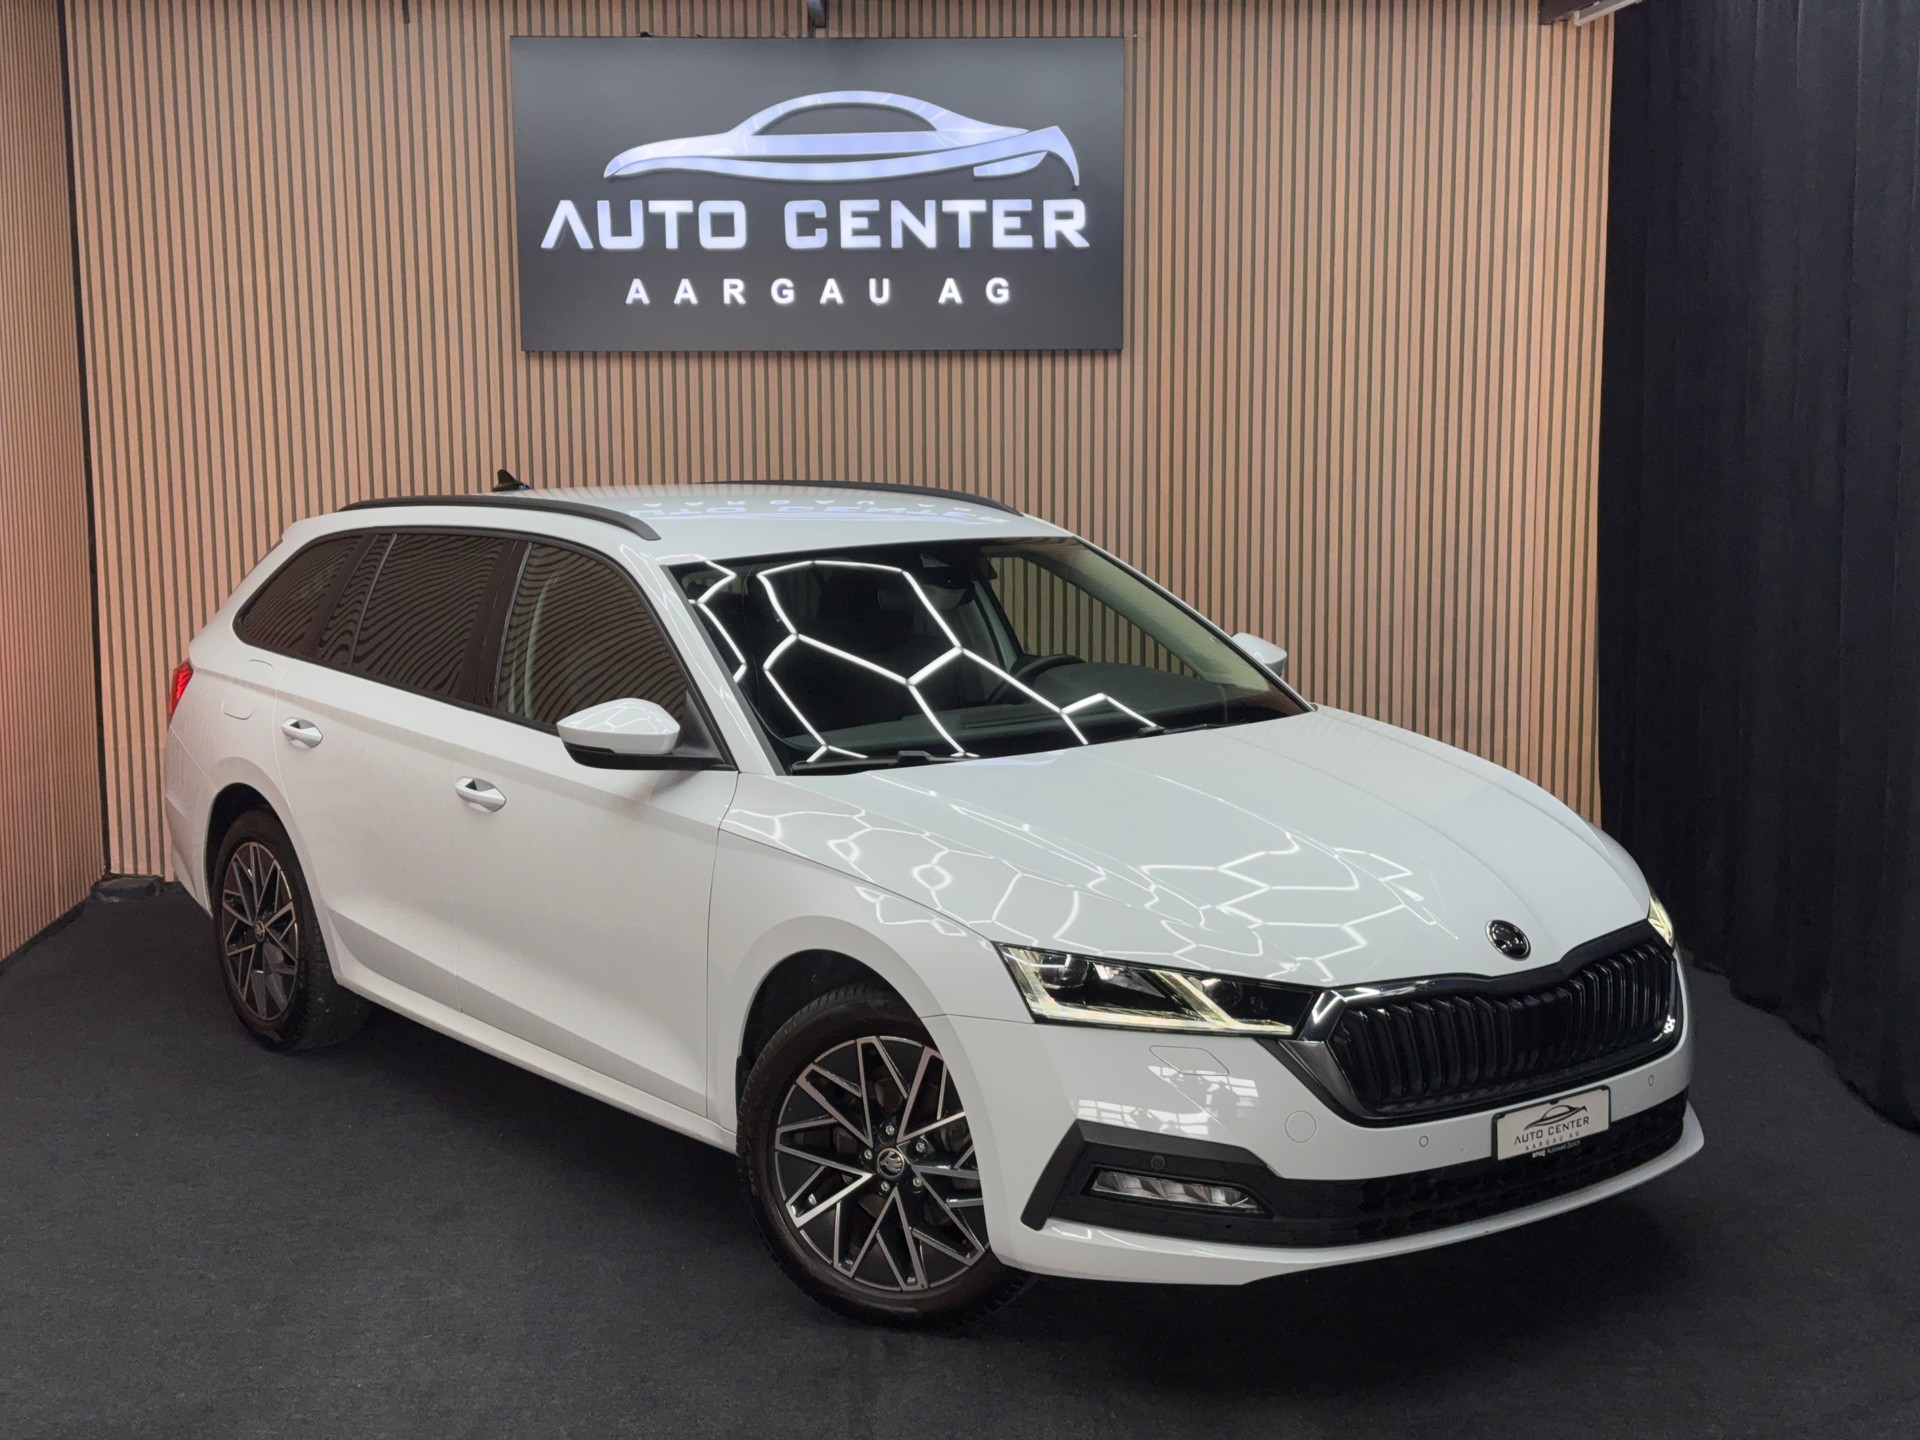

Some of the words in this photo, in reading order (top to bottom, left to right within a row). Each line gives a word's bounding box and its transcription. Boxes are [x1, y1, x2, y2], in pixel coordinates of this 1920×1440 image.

[540, 199, 747, 250] AUTO
[784, 199, 1090, 250] CENTER
[625, 277, 892, 306] AARGAU
[937, 277, 1011, 305] AG
[1514, 1129, 1544, 1145] AUTO
[1548, 1116, 1590, 1136] CENTER
